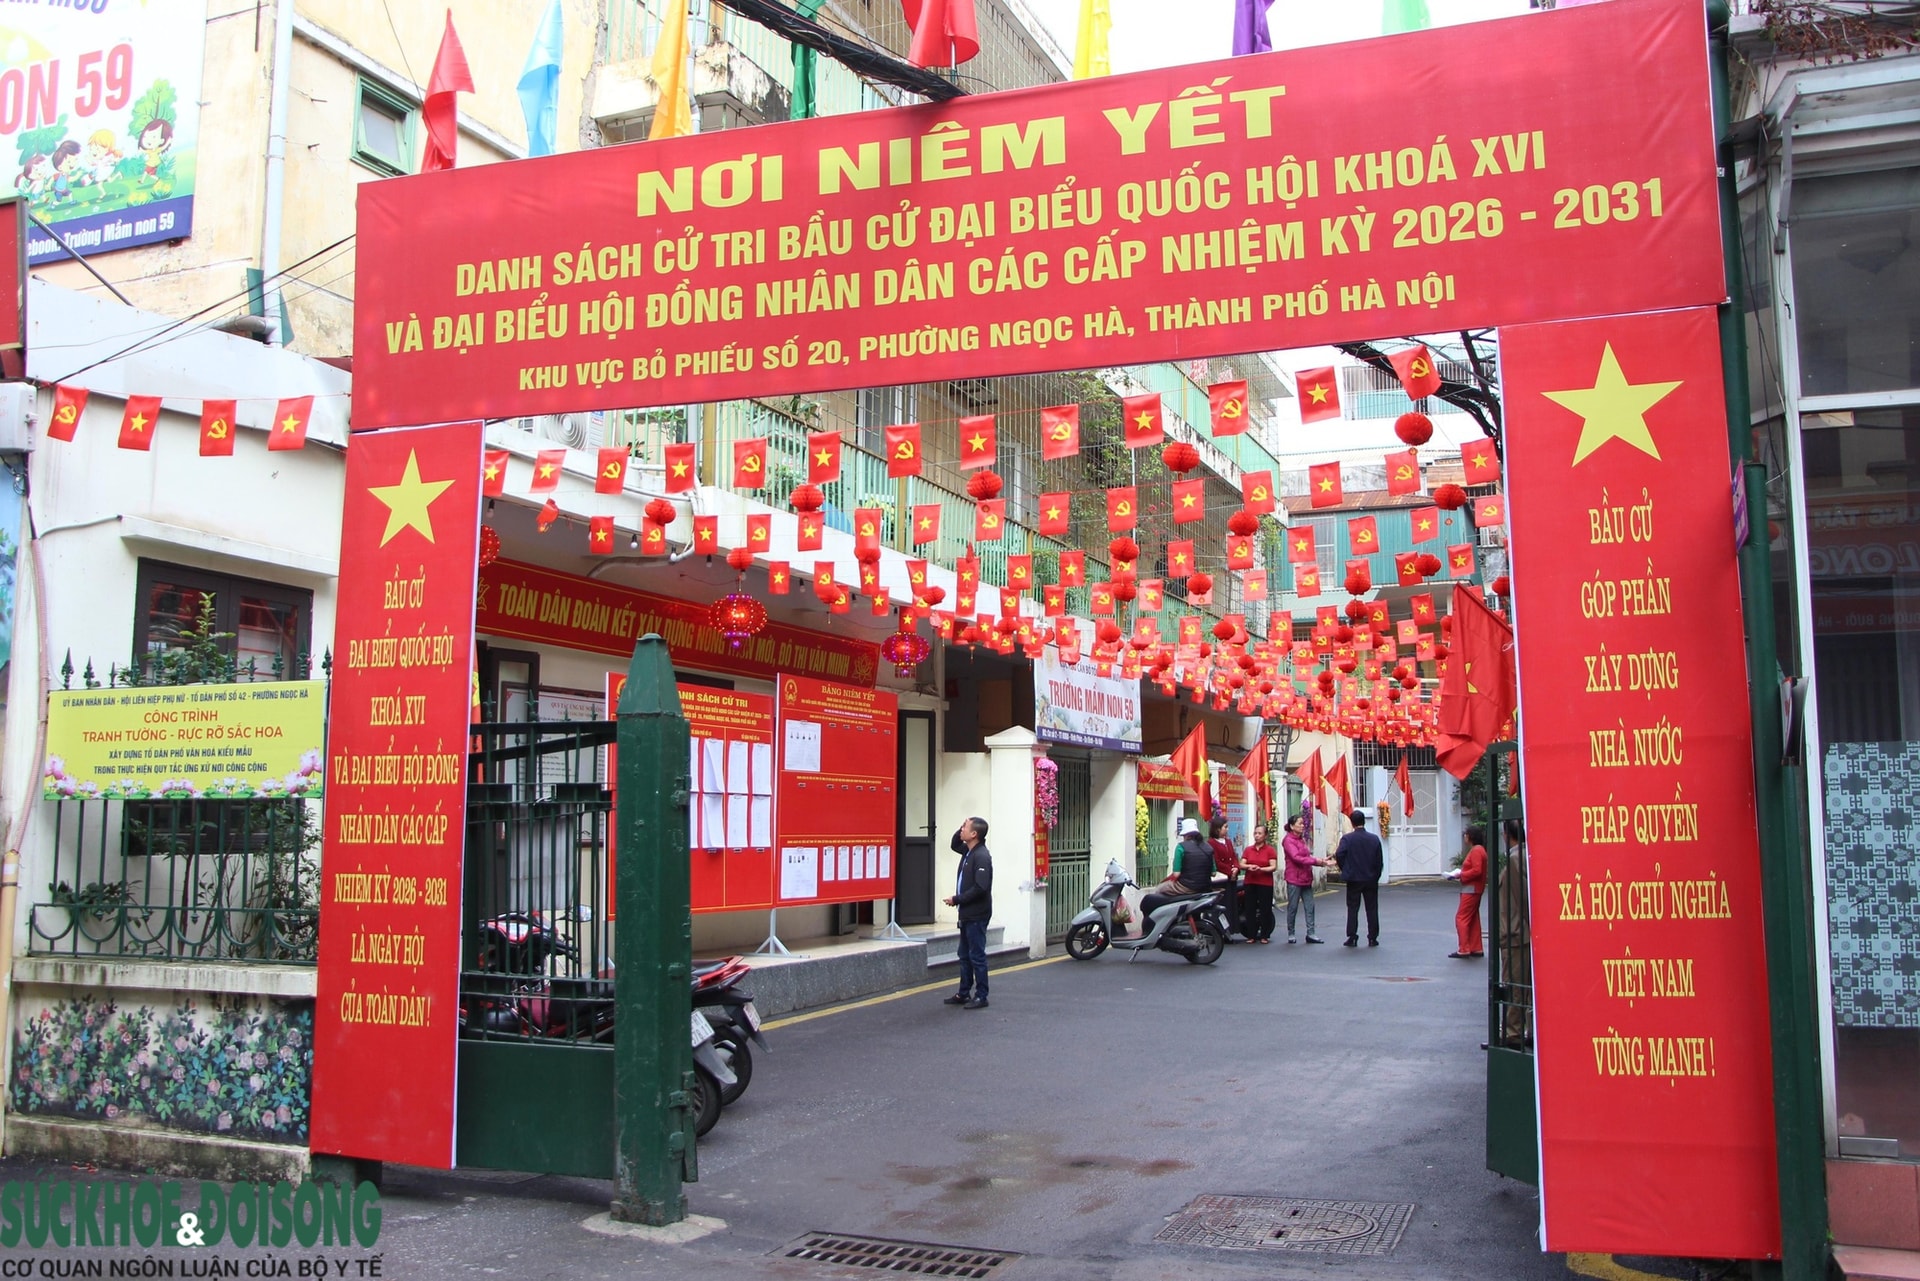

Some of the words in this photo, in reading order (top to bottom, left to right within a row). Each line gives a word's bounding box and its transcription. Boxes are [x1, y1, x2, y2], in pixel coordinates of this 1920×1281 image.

[75, 44, 133, 118] 59
[637, 153, 783, 217] NƠI
[818, 115, 1067, 195] NIÊM
[1101, 75, 1288, 155] YẾT
[64, 228, 101, 249] Trường
[104, 219, 132, 242] Mầm
[135, 218, 156, 236] non
[158, 211, 175, 230] 59
[456, 255, 542, 296] DANH
[553, 242, 641, 286] SÁCH
[654, 225, 703, 274] CỬ
[710, 229, 765, 268] TRI
[779, 210, 852, 261] BẦU
[867, 200, 921, 250] CỬ
[929, 201, 995, 247] ĐẠI
[1010, 175, 1102, 234] BIỂU
[1117, 161, 1231, 224] QUỐC
[1246, 155, 1319, 209] HỘI
[1334, 134, 1457, 194] KHOÁ
[1471, 130, 1545, 177] XVI
[386, 313, 423, 354] VÀ
[432, 312, 484, 354] ĐẠI
[495, 292, 568, 343] BIỂU
[579, 291, 634, 340] HỘI
[645, 278, 743, 328] ĐỒNG
[756, 269, 860, 317] NHÂN
[874, 258, 954, 305] DÂN
[969, 247, 1048, 295] CÁC
[1064, 228, 1147, 284] CẤP
[1162, 218, 1305, 273] NHIỆM
[1321, 205, 1376, 256] KỲ
[1393, 198, 1504, 248] 2026
[1553, 178, 1662, 229] 2031
[519, 365, 568, 390] KHU
[576, 358, 624, 389] VỰC
[633, 348, 666, 380] BỎ
[675, 342, 753, 377] PHIẾU
[762, 335, 799, 369] SỐ
[808, 340, 849, 365] 20,
[860, 325, 979, 361] PHƯỜNG
[990, 316, 1073, 348] NGỌC
[1084, 306, 1134, 338] HÀ,
[1145, 297, 1251, 331] THÀNH
[1263, 279, 1328, 320] PHỐ
[1340, 278, 1386, 312] HÀ
[1396, 271, 1455, 309] NỘI
[1589, 487, 1624, 544] BẦU
[1630, 487, 1652, 542] CỬ
[384, 564, 407, 609] BẦU
[409, 565, 425, 608] CỬ
[1581, 569, 1616, 618] GÓP
[1620, 557, 1670, 616] PHẦN
[349, 640, 369, 675] ĐẠI
[371, 618, 398, 667] BIỂU
[399, 622, 431, 668] QUỐC
[432, 626, 454, 672] HỘI
[498, 581, 539, 620] TOÀN
[539, 589, 571, 626] DÂN
[571, 598, 612, 633] ĐOÀN
[611, 602, 636, 638] KẾT
[664, 617, 693, 652] DỰNG
[778, 642, 792, 667] ĐÔ
[794, 644, 807, 675] THỊ
[827, 650, 850, 677] MINH
[1584, 643, 1622, 692] XÂY
[1627, 647, 1678, 700] DỰNG
[72, 698, 84, 706] BAN
[239, 692, 246, 700] 42
[144, 709, 178, 723] CÔNG
[182, 708, 218, 722] TRÌNH
[370, 687, 402, 726] KHOÁ
[404, 696, 426, 725] XVI
[697, 692, 720, 704] SÁCH
[735, 699, 748, 708] TRI
[1048, 677, 1083, 711] TRƯỜNG
[1085, 683, 1105, 716] MẦM
[1107, 694, 1123, 719] NON
[1125, 698, 1134, 721] 59
[83, 731, 122, 742] TRANH
[126, 727, 167, 741] TƯỜNG
[178, 728, 203, 742] RỰC
[206, 725, 224, 739] RỠ
[227, 722, 251, 739] SẮC
[255, 726, 283, 738] HOA
[1589, 718, 1629, 767] NHÀ
[1633, 715, 1682, 766] NƯỚC
[94, 765, 116, 775] TRONG
[118, 765, 135, 775] THỰC
[136, 764, 152, 775] HIỆN
[154, 765, 167, 774] QUY
[212, 763, 224, 773] NƠI
[226, 762, 245, 772] CÔNG
[247, 762, 267, 773] CỘNG
[335, 747, 349, 784] VÀ
[351, 756, 372, 792] ĐẠI
[374, 735, 401, 784] BIỂU
[403, 745, 424, 792] HỘI
[426, 738, 459, 784] ĐỒNG
[339, 805, 372, 843] NHÂN
[374, 805, 399, 843] DÂN
[401, 805, 423, 844] CÁC
[425, 800, 447, 844] CẤP
[1581, 793, 1629, 843] PHÁP
[1634, 782, 1697, 845] QUYỀN
[334, 864, 372, 910] NHIỆM
[374, 865, 391, 903] KỲ
[393, 877, 416, 904] 2026
[425, 878, 447, 905] 2031
[1559, 873, 1585, 920] XÃ
[1590, 869, 1623, 930] HỘI
[1628, 863, 1664, 920] CHỦ
[1670, 871, 1731, 919] NGHĨA
[351, 925, 365, 962] LÀ
[369, 926, 401, 964] NGÀY
[403, 926, 424, 972] HỘI
[341, 978, 363, 1022] CỦA
[367, 986, 398, 1024] TOÀN
[1603, 946, 1645, 1008] VIỆT
[1650, 959, 1695, 996] NAM
[1592, 1026, 1644, 1076] VỮNG
